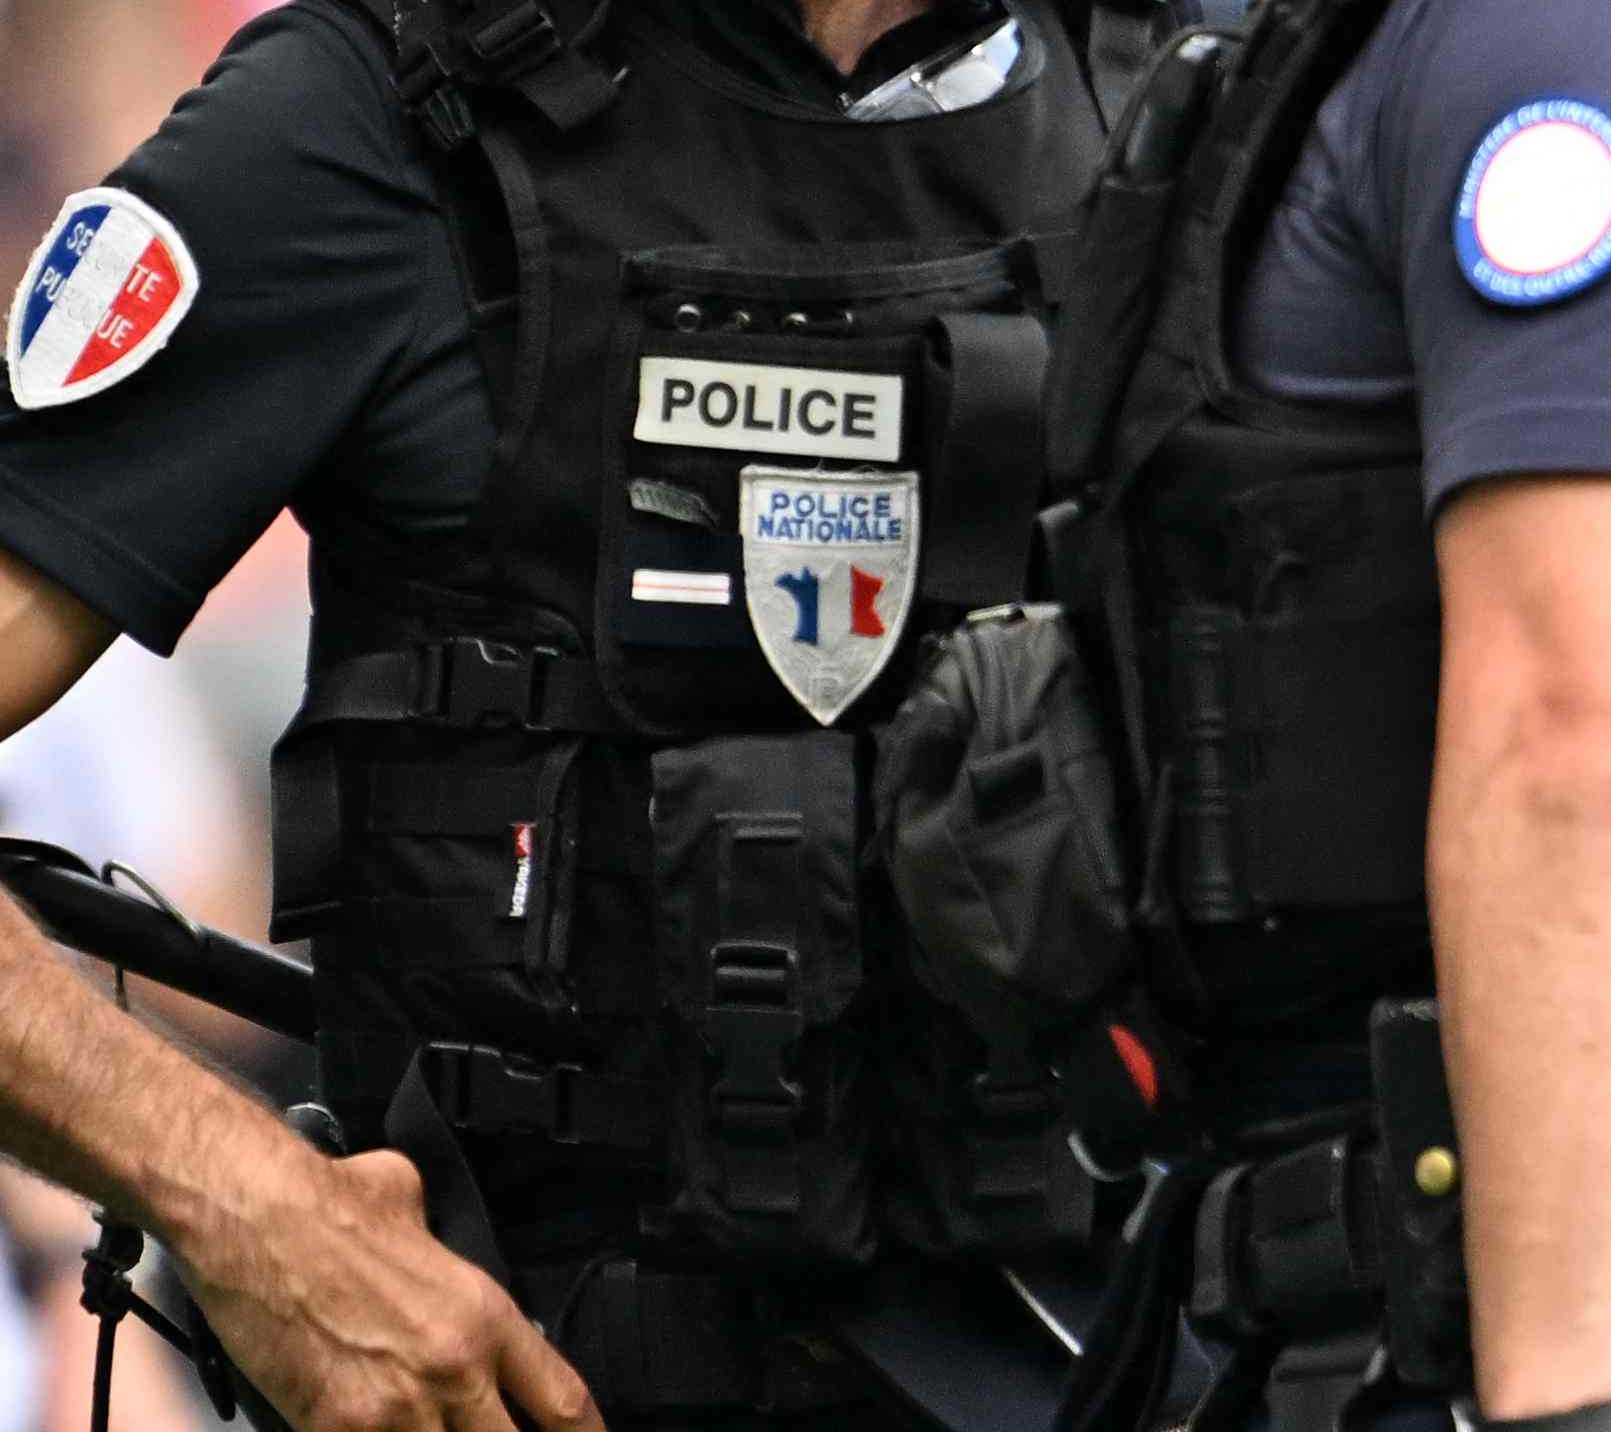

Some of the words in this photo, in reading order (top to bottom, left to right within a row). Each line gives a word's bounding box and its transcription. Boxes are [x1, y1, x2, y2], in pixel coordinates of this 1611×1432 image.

[661, 378, 877, 439] POLICE
[770, 491, 891, 518] POLICE
[757, 515, 901, 543] NATIONALE
